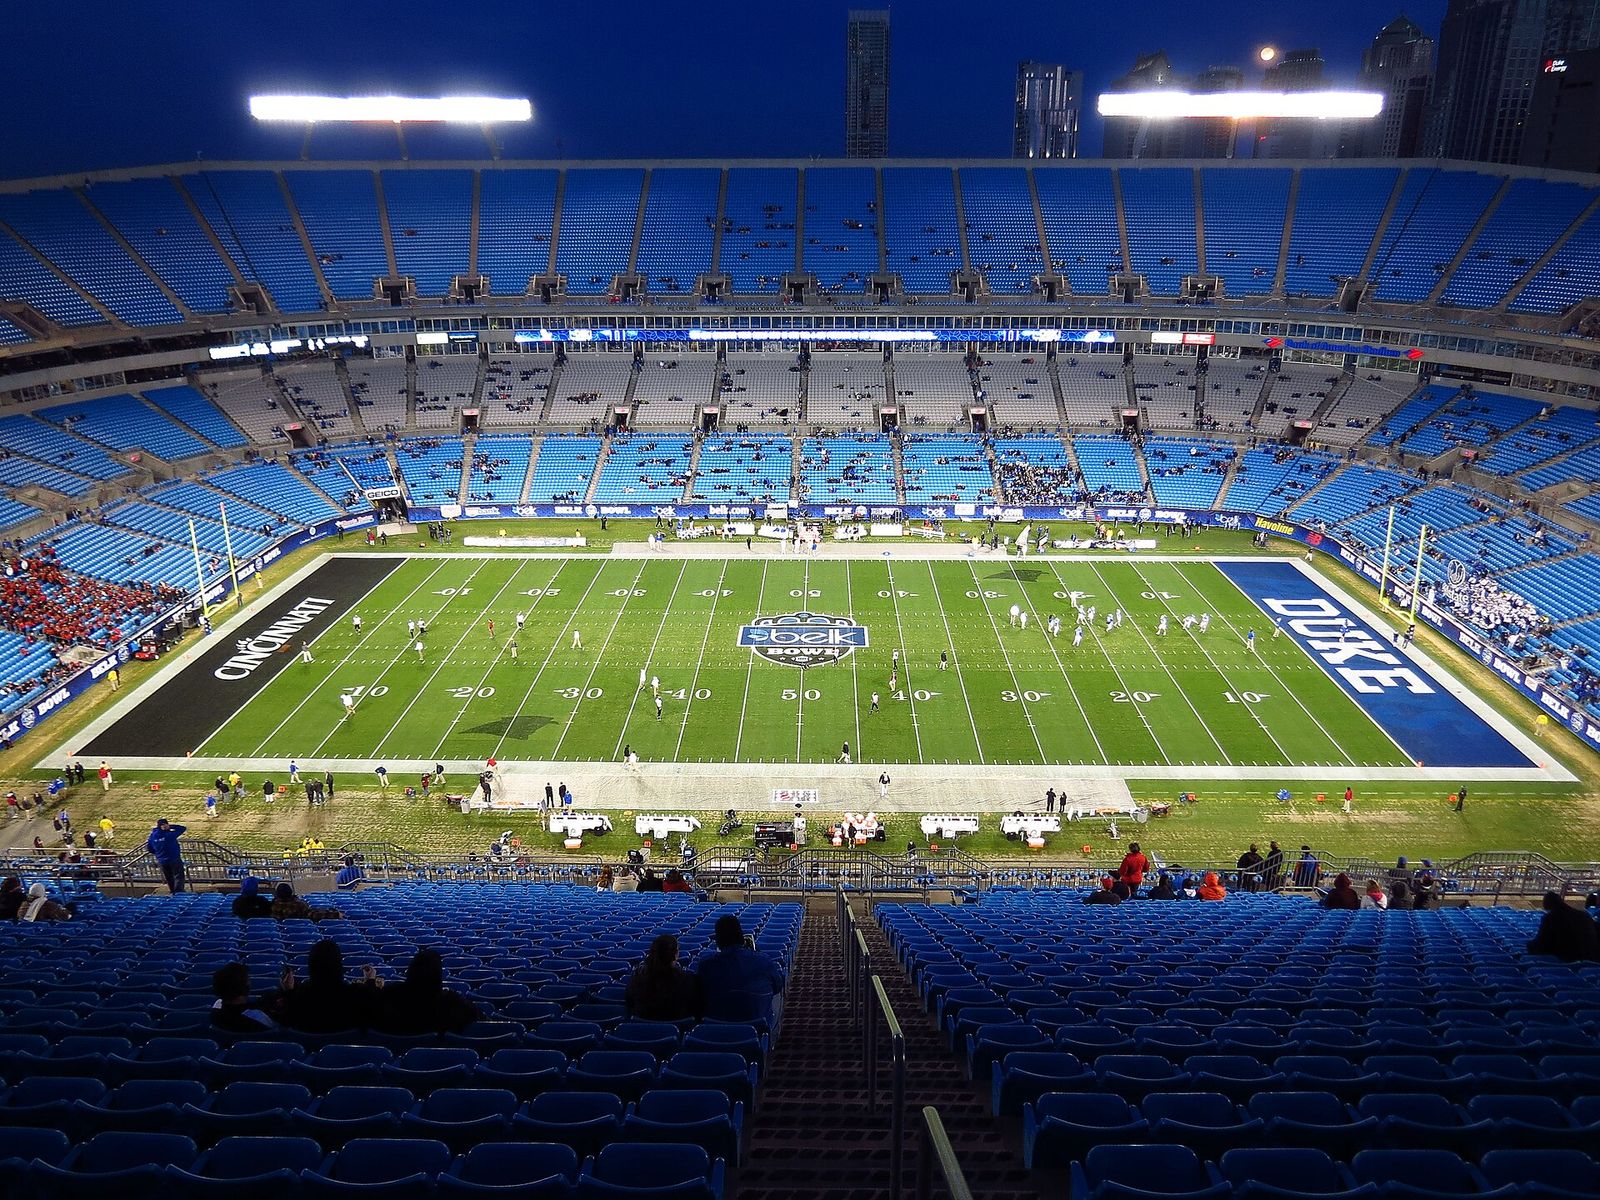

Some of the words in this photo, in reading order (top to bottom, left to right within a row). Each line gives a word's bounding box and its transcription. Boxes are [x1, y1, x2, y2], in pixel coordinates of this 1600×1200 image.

[367, 489, 399, 499] GEICO
[600, 506, 632, 514] BOWL
[709, 505, 750, 515] belk.com
[1254, 517, 1295, 535] Havoline
[1422, 604, 1444, 627] BOWL
[213, 597, 336, 681] CINCINNATI
[770, 628, 858, 645] belk
[1261, 597, 1437, 694] DUKE
[767, 648, 840, 656] BOWL
[1458, 631, 1482, 655] BELK
[1493, 657, 1521, 684] BOWL
[90, 654, 119, 680] BELK
[452, 686, 495, 698] 20
[563, 687, 604, 699] 30
[671, 688, 711, 700] 40
[781, 689, 821, 700] 50
[891, 690, 931, 701] 40
[1001, 690, 1041, 702] 30
[1109, 691, 1151, 703] 20
[1221, 691, 1261, 703] 10
[37, 687, 71, 716] BOWL
[1540, 691, 1570, 720] BELK
